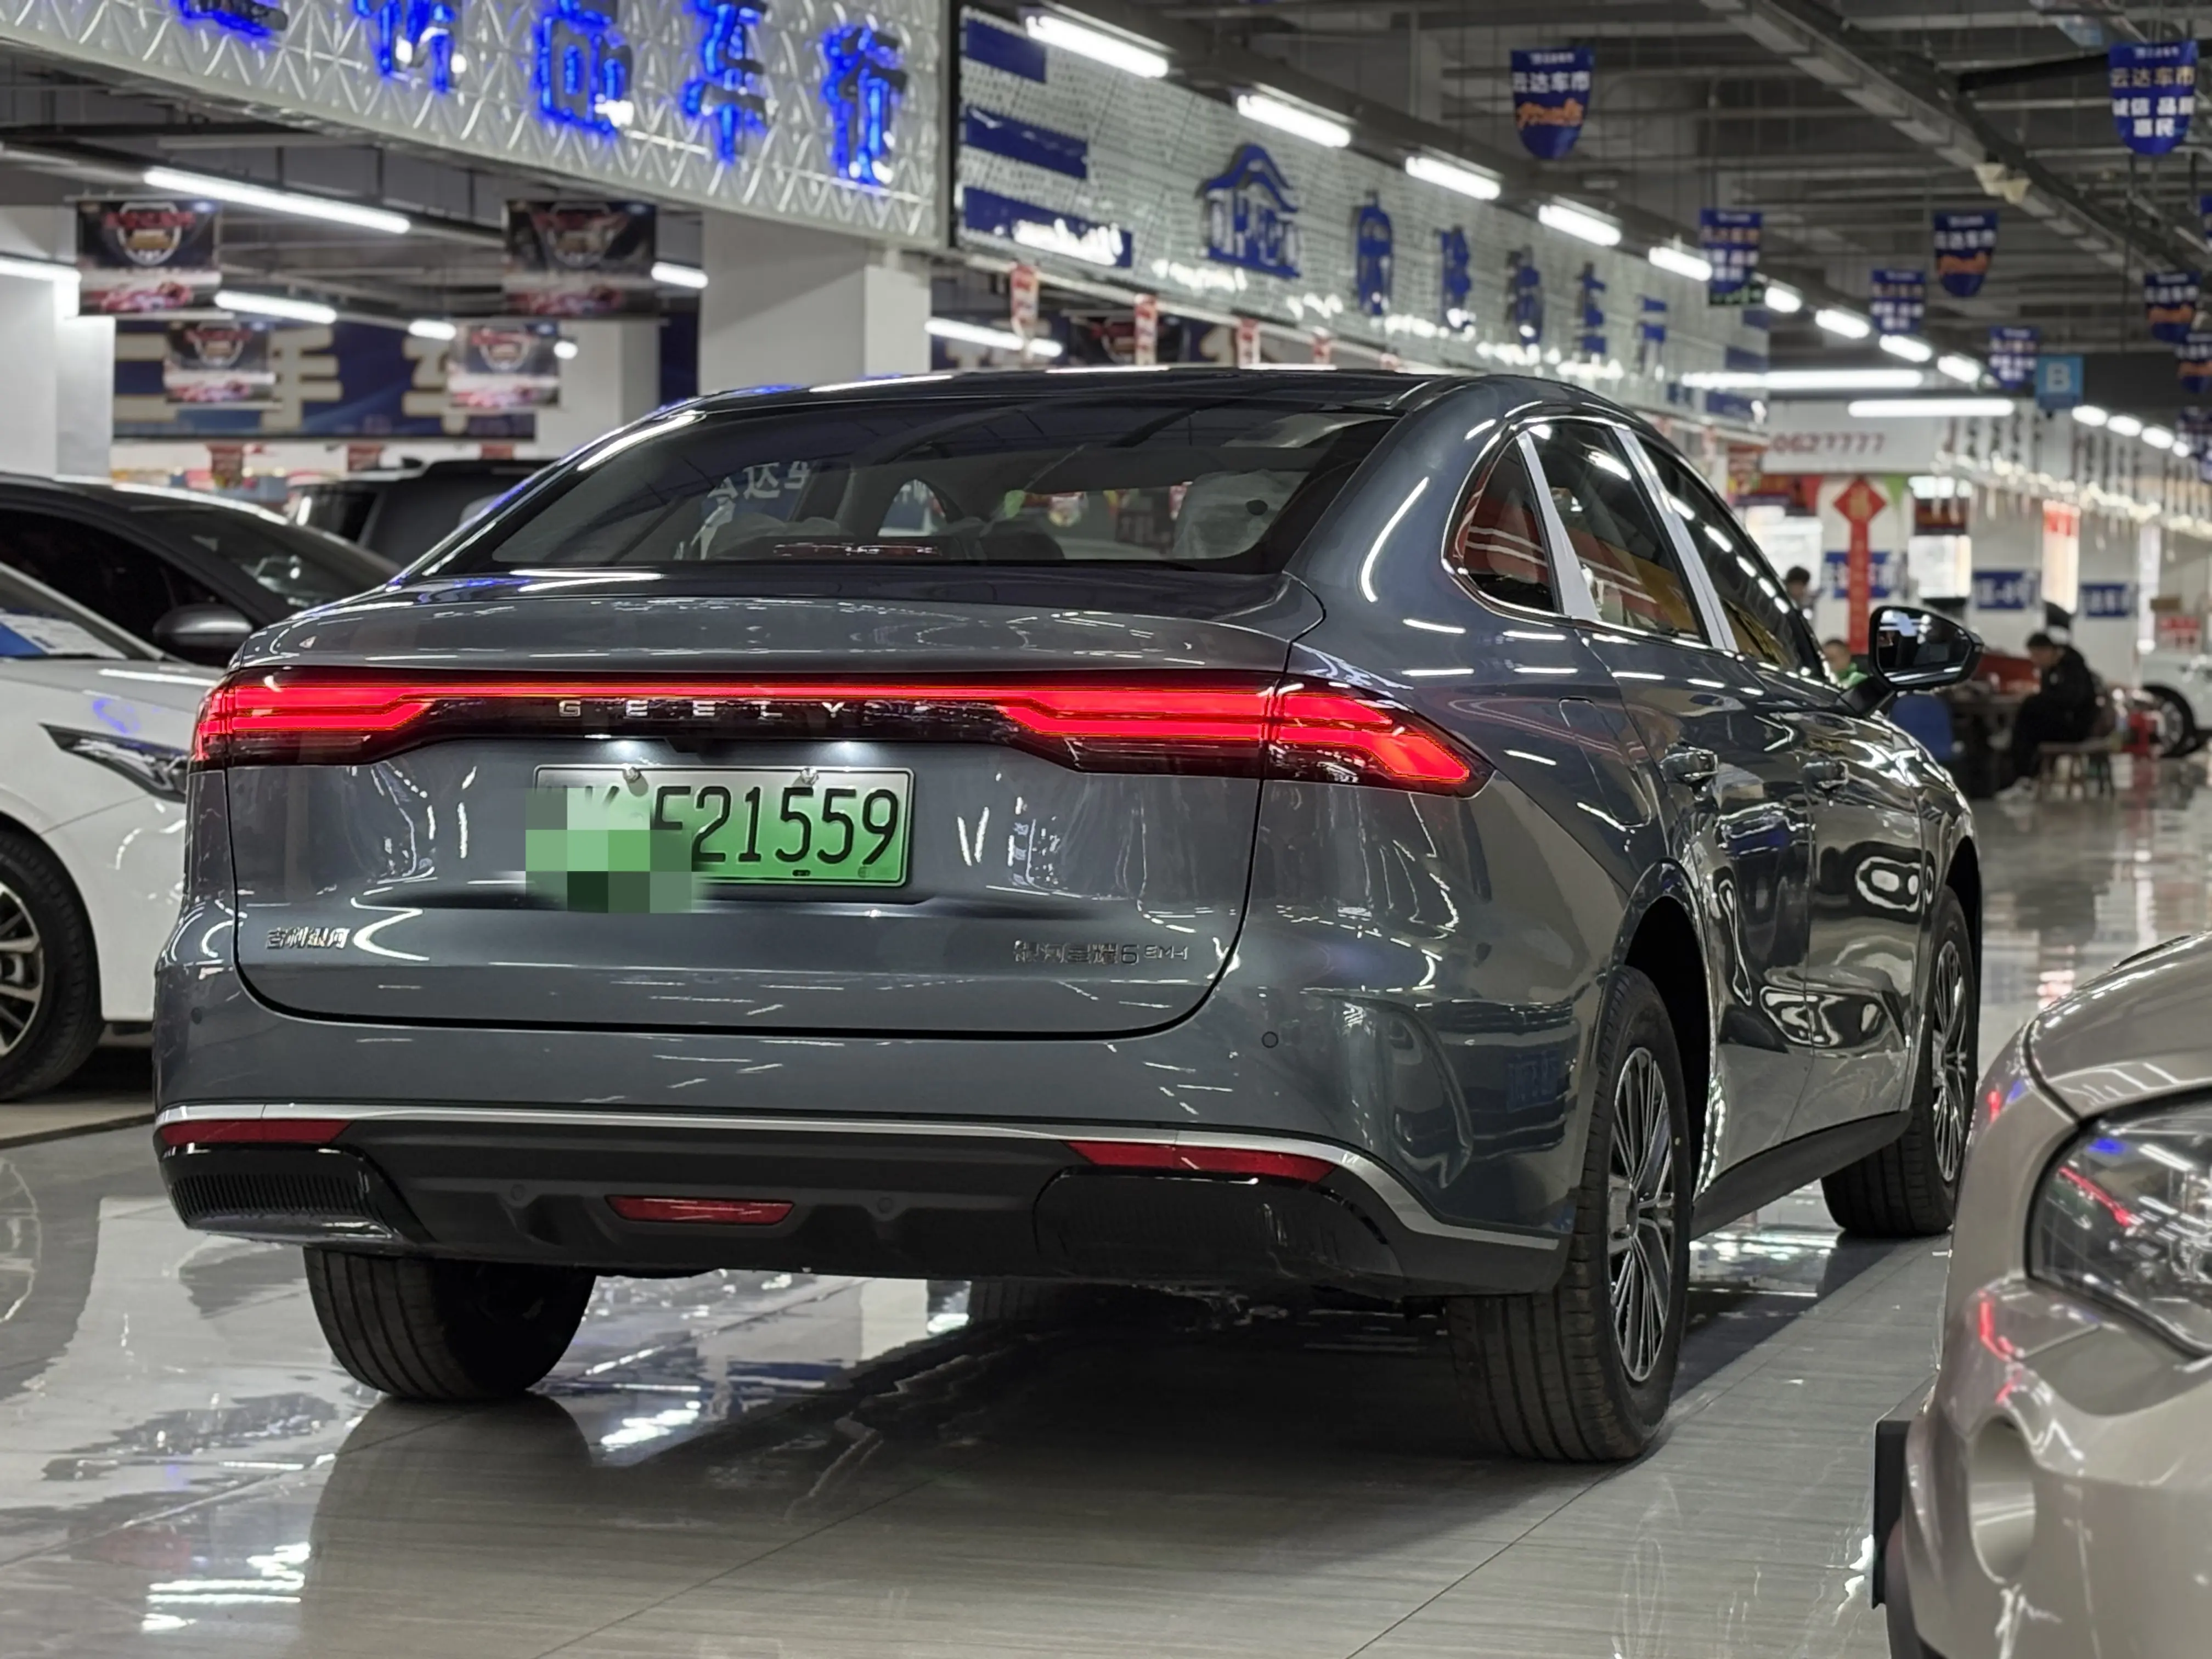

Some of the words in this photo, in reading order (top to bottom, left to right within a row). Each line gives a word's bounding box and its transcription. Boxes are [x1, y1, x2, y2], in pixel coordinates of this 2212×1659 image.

[2111, 66, 2195, 87] 云达车市
[2046, 361, 2072, 393] B
[558, 699, 845, 717] GEELY
[545, 785, 899, 866] F21559
[266, 926, 352, 950] 吉利银河
